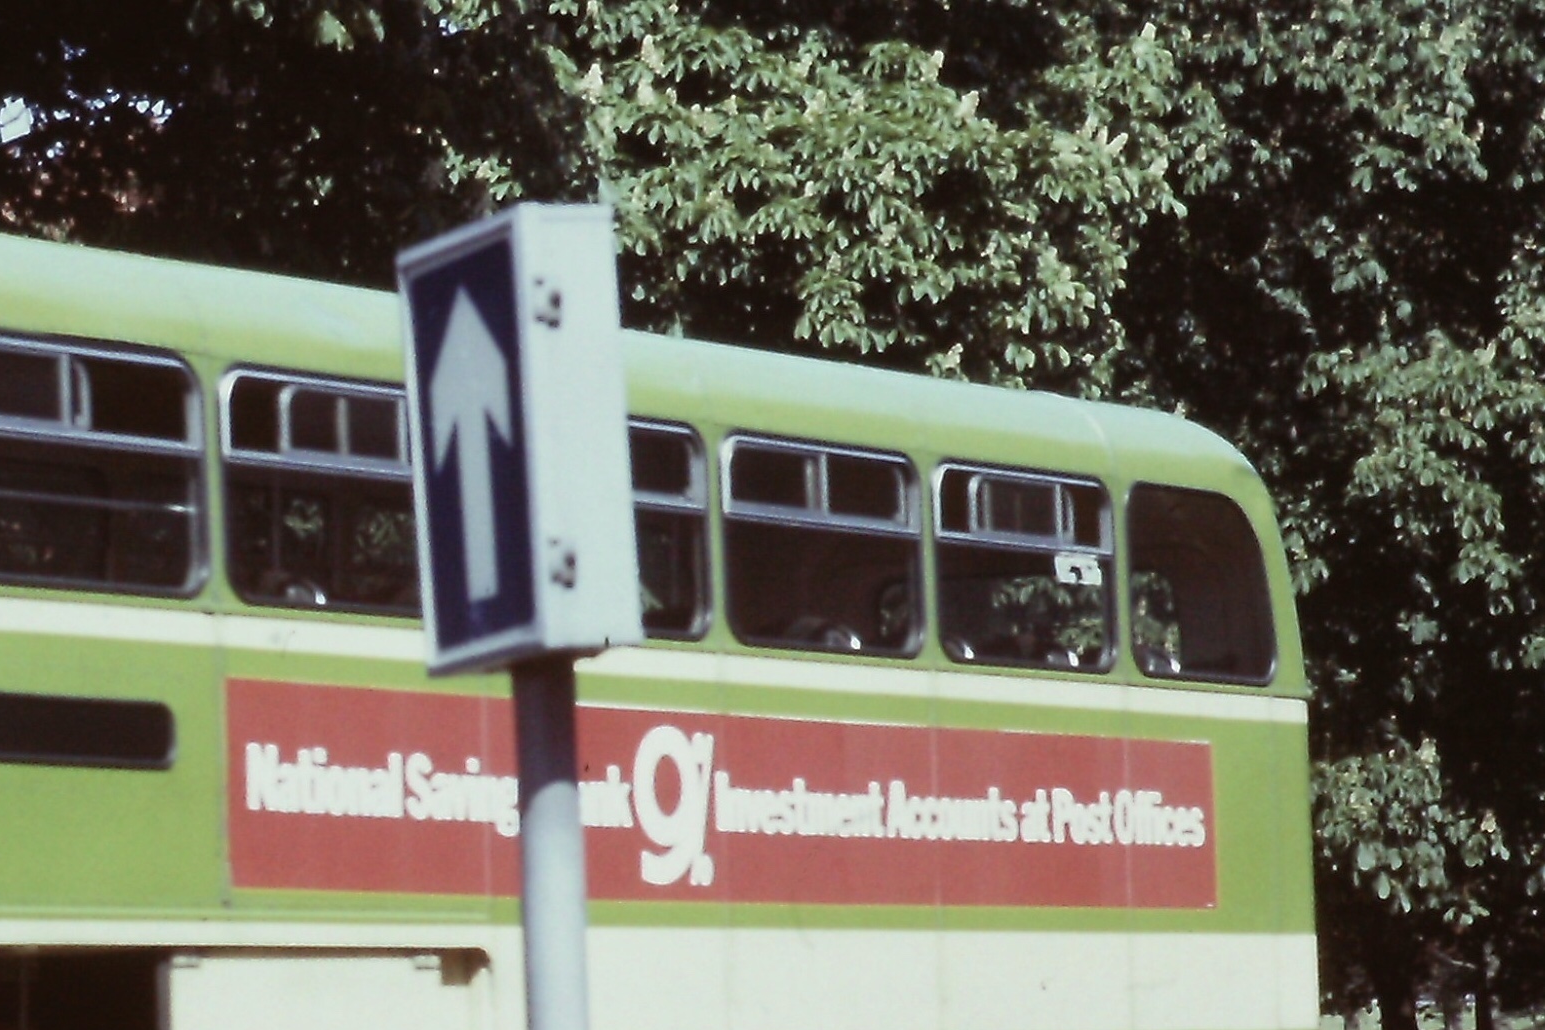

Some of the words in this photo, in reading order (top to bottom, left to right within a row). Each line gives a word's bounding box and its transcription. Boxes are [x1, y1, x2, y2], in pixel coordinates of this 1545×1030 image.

[245, 742, 404, 817] National
[405, 752, 520, 836] Saving
[715, 770, 886, 838] Investment
[887, 780, 1019, 842] Accounts
[1021, 789, 1051, 843] at
[1052, 788, 1113, 845] Post
[1115, 789, 1205, 847] Offices
